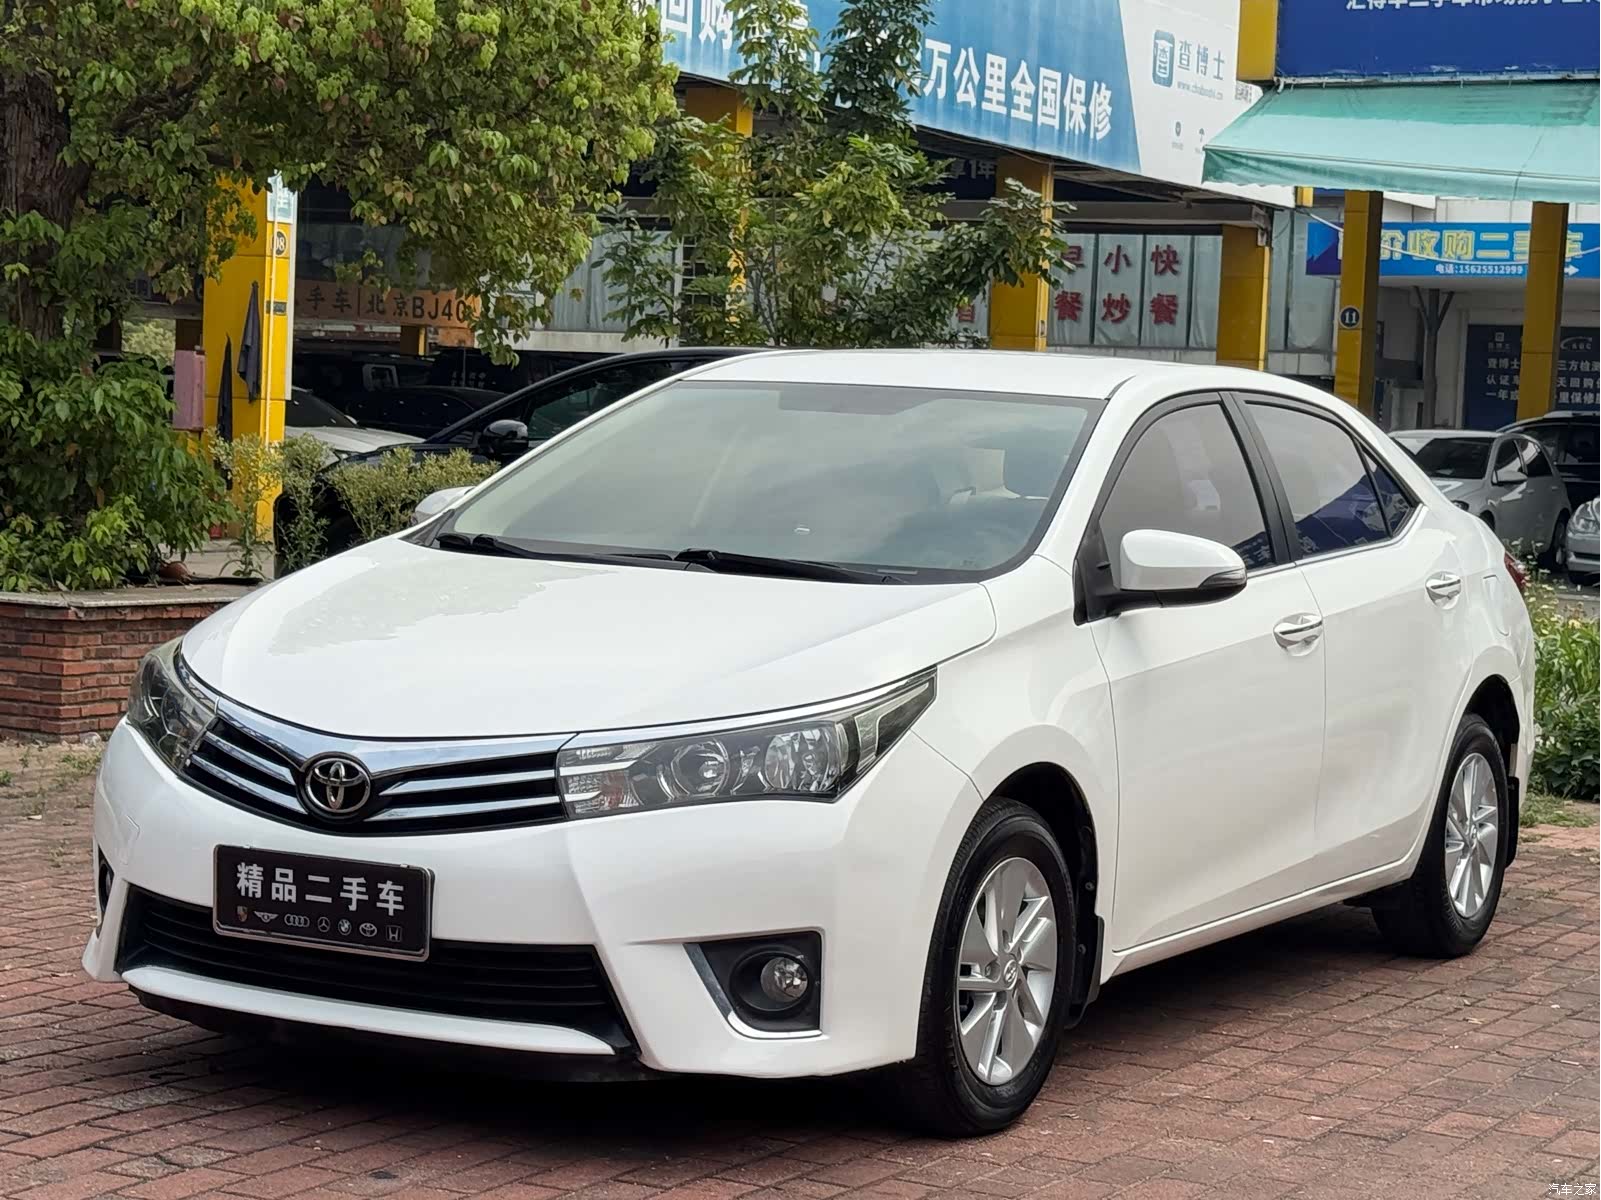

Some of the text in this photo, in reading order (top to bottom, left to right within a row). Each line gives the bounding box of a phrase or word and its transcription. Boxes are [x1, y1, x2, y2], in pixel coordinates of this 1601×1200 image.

[1345, 311, 1357, 324] 11
[236, 862, 405, 917] 精品二手车
